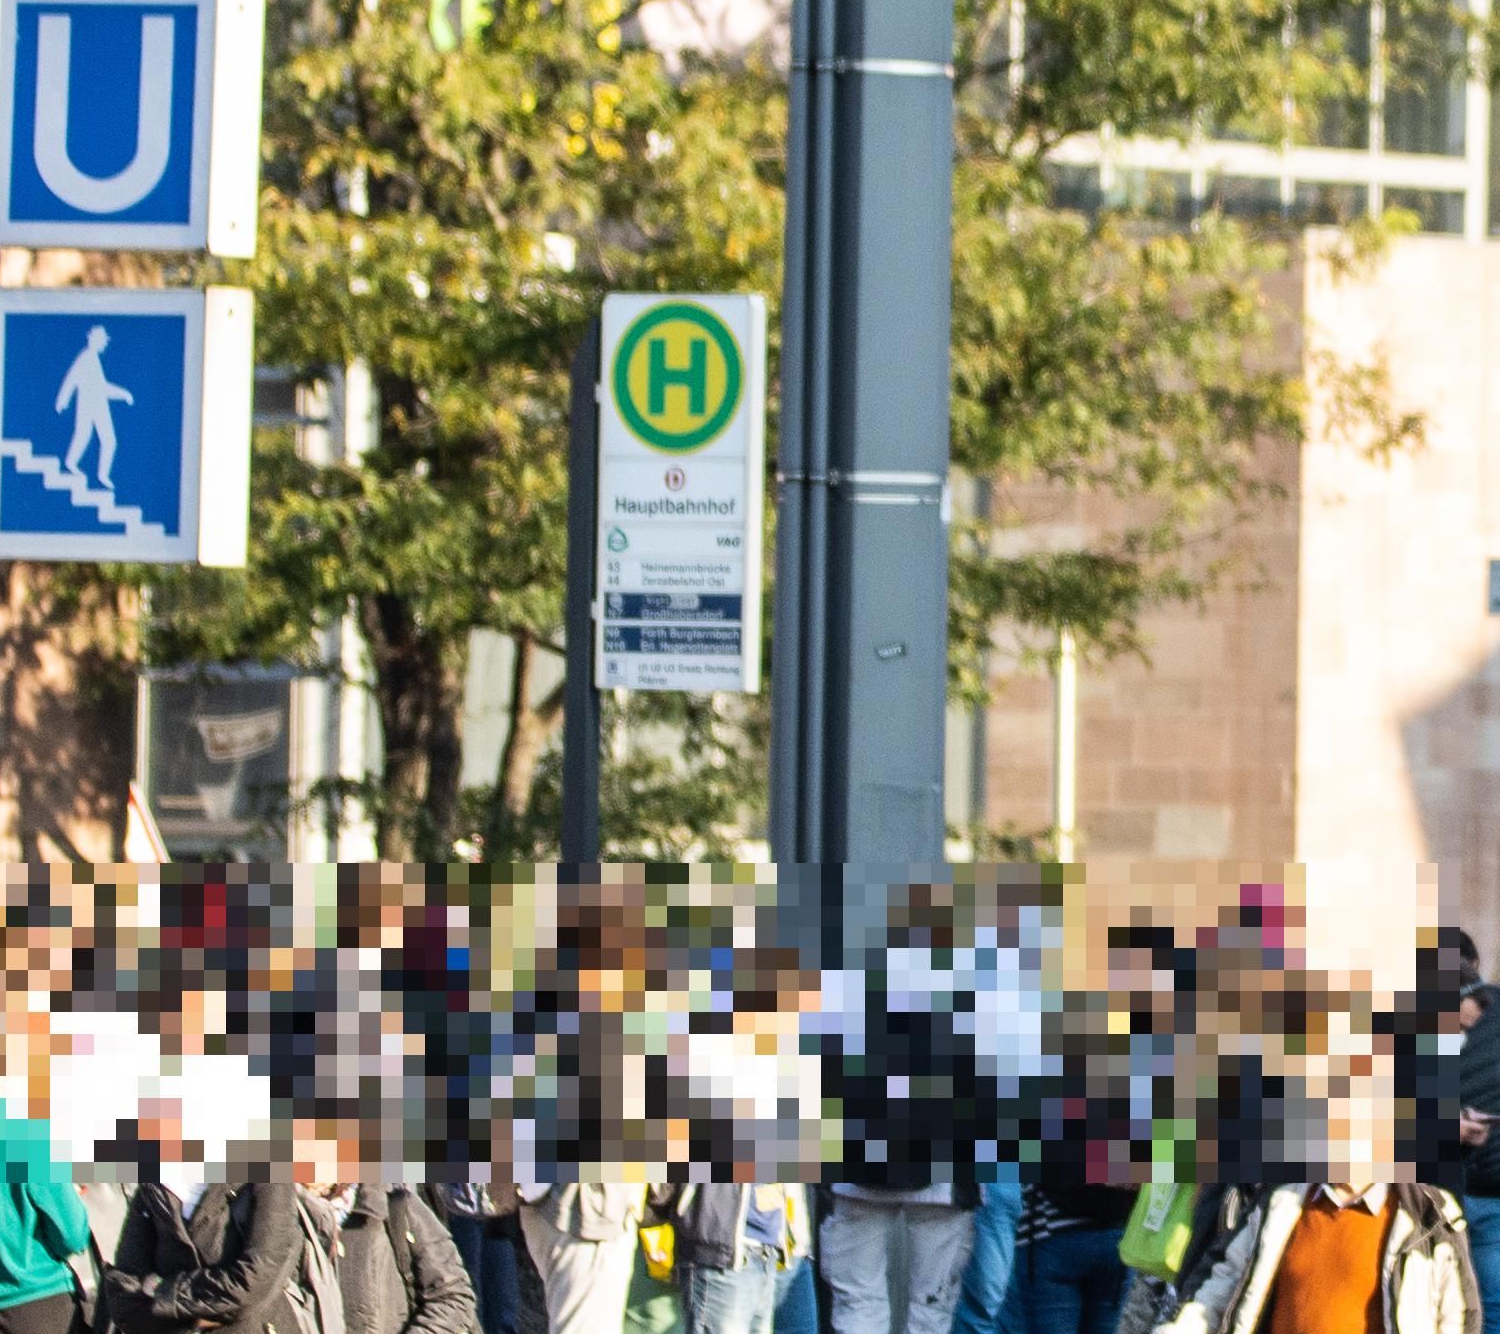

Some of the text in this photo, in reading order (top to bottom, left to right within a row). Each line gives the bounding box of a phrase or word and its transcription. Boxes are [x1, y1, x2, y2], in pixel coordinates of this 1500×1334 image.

[33, 14, 176, 214] U
[648, 339, 707, 415] H
[615, 496, 736, 516] Hauptbahnhof
[716, 536, 741, 548] VAG
